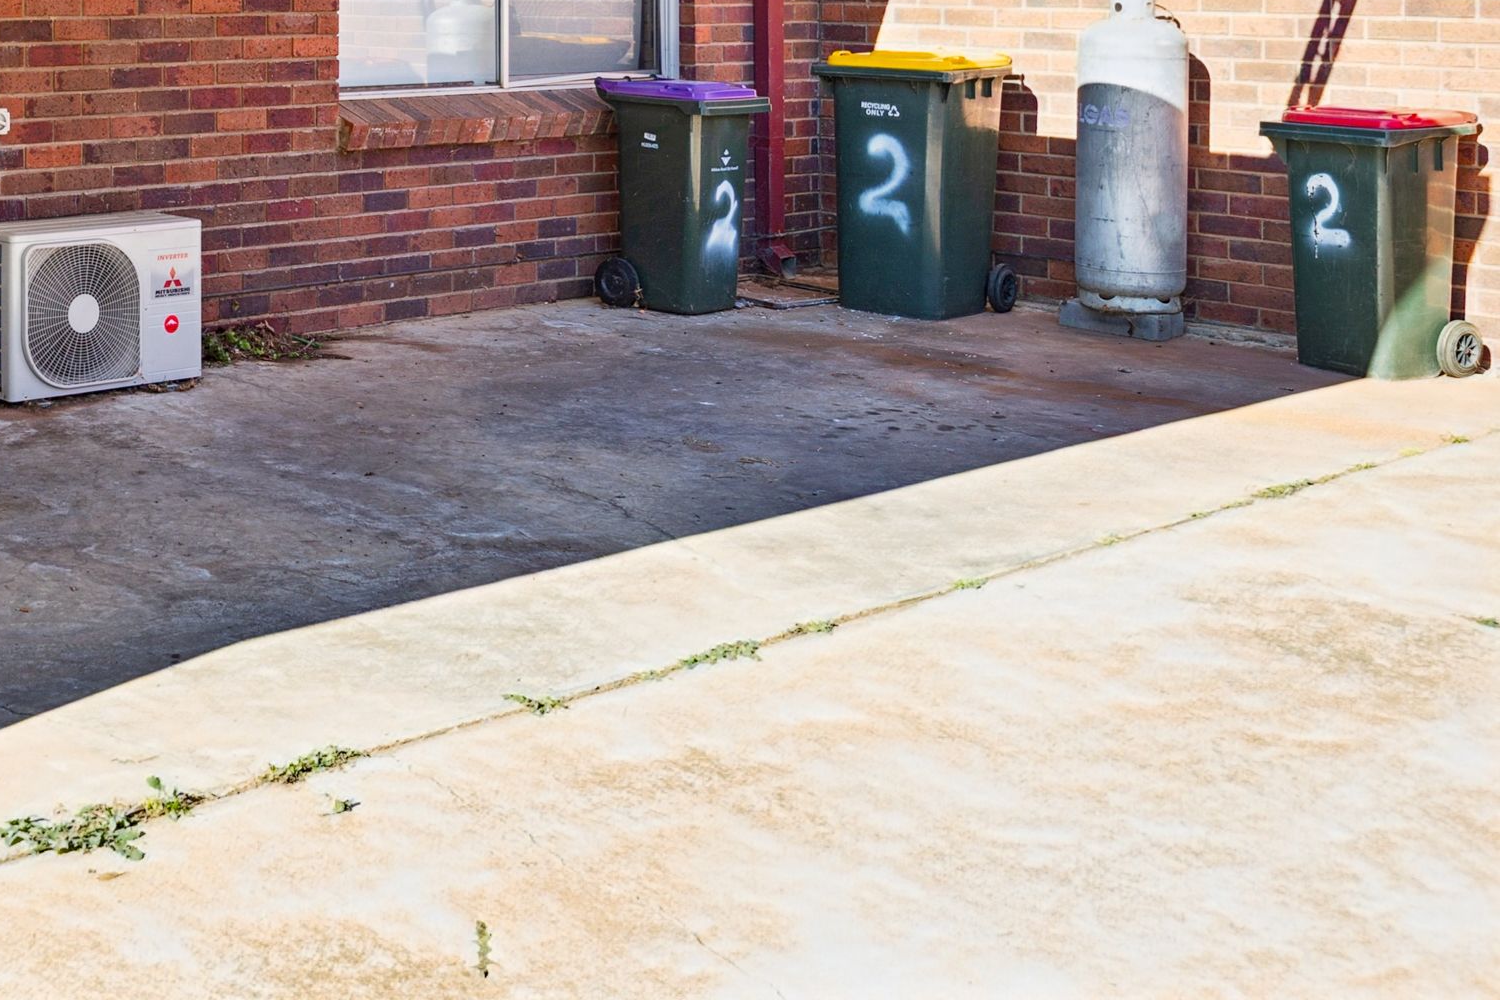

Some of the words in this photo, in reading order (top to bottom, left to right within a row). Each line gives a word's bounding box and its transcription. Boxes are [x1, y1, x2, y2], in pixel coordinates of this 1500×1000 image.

[861, 101, 891, 111] RECYCLING
[866, 108, 885, 117] ONLY
[859, 133, 910, 236] 2
[1306, 172, 1350, 250] 2
[157, 252, 188, 261] INVERTER
[155, 287, 191, 295] MITSUBISHI
